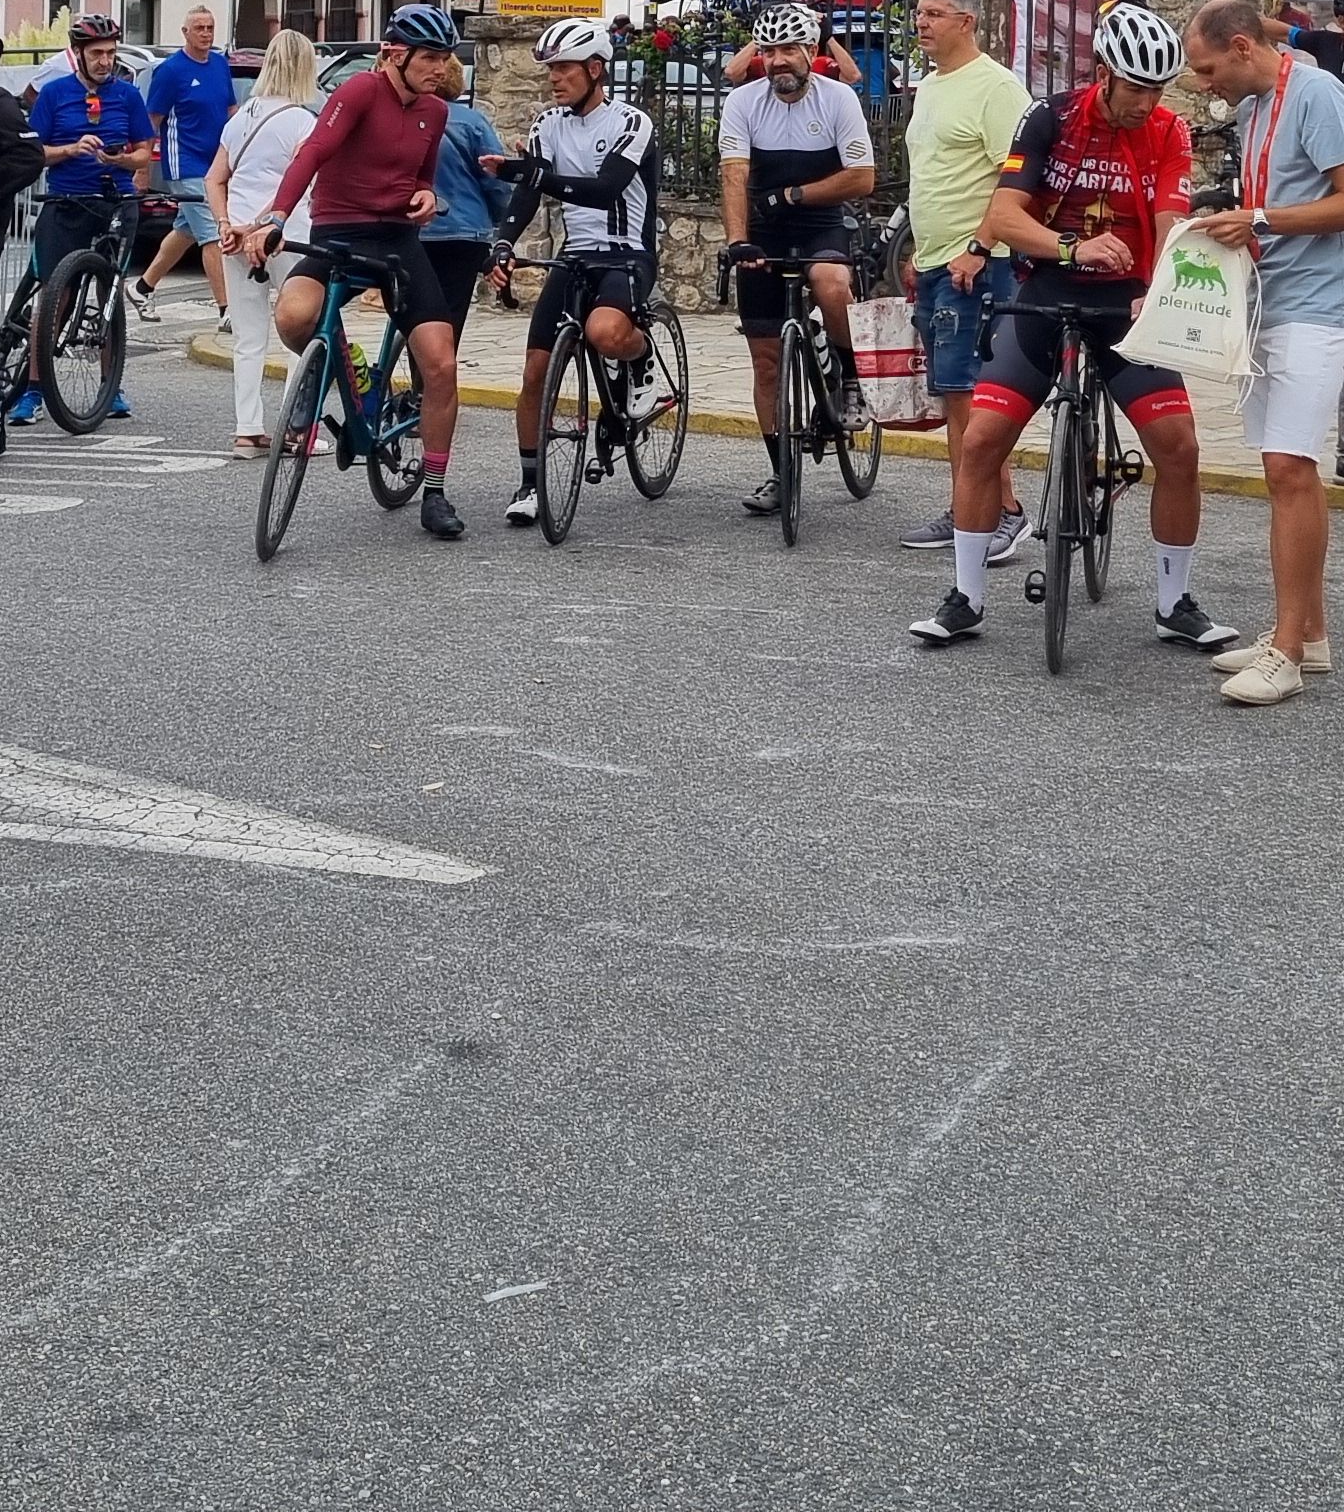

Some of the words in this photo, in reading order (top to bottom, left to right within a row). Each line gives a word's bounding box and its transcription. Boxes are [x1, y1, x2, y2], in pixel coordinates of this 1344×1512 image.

[500, 3, 534, 12] Itinerario
[535, 4, 567, 13] Cultural
[568, 6, 600, 14] Europeo
[1158, 295, 1233, 319] plenitude
